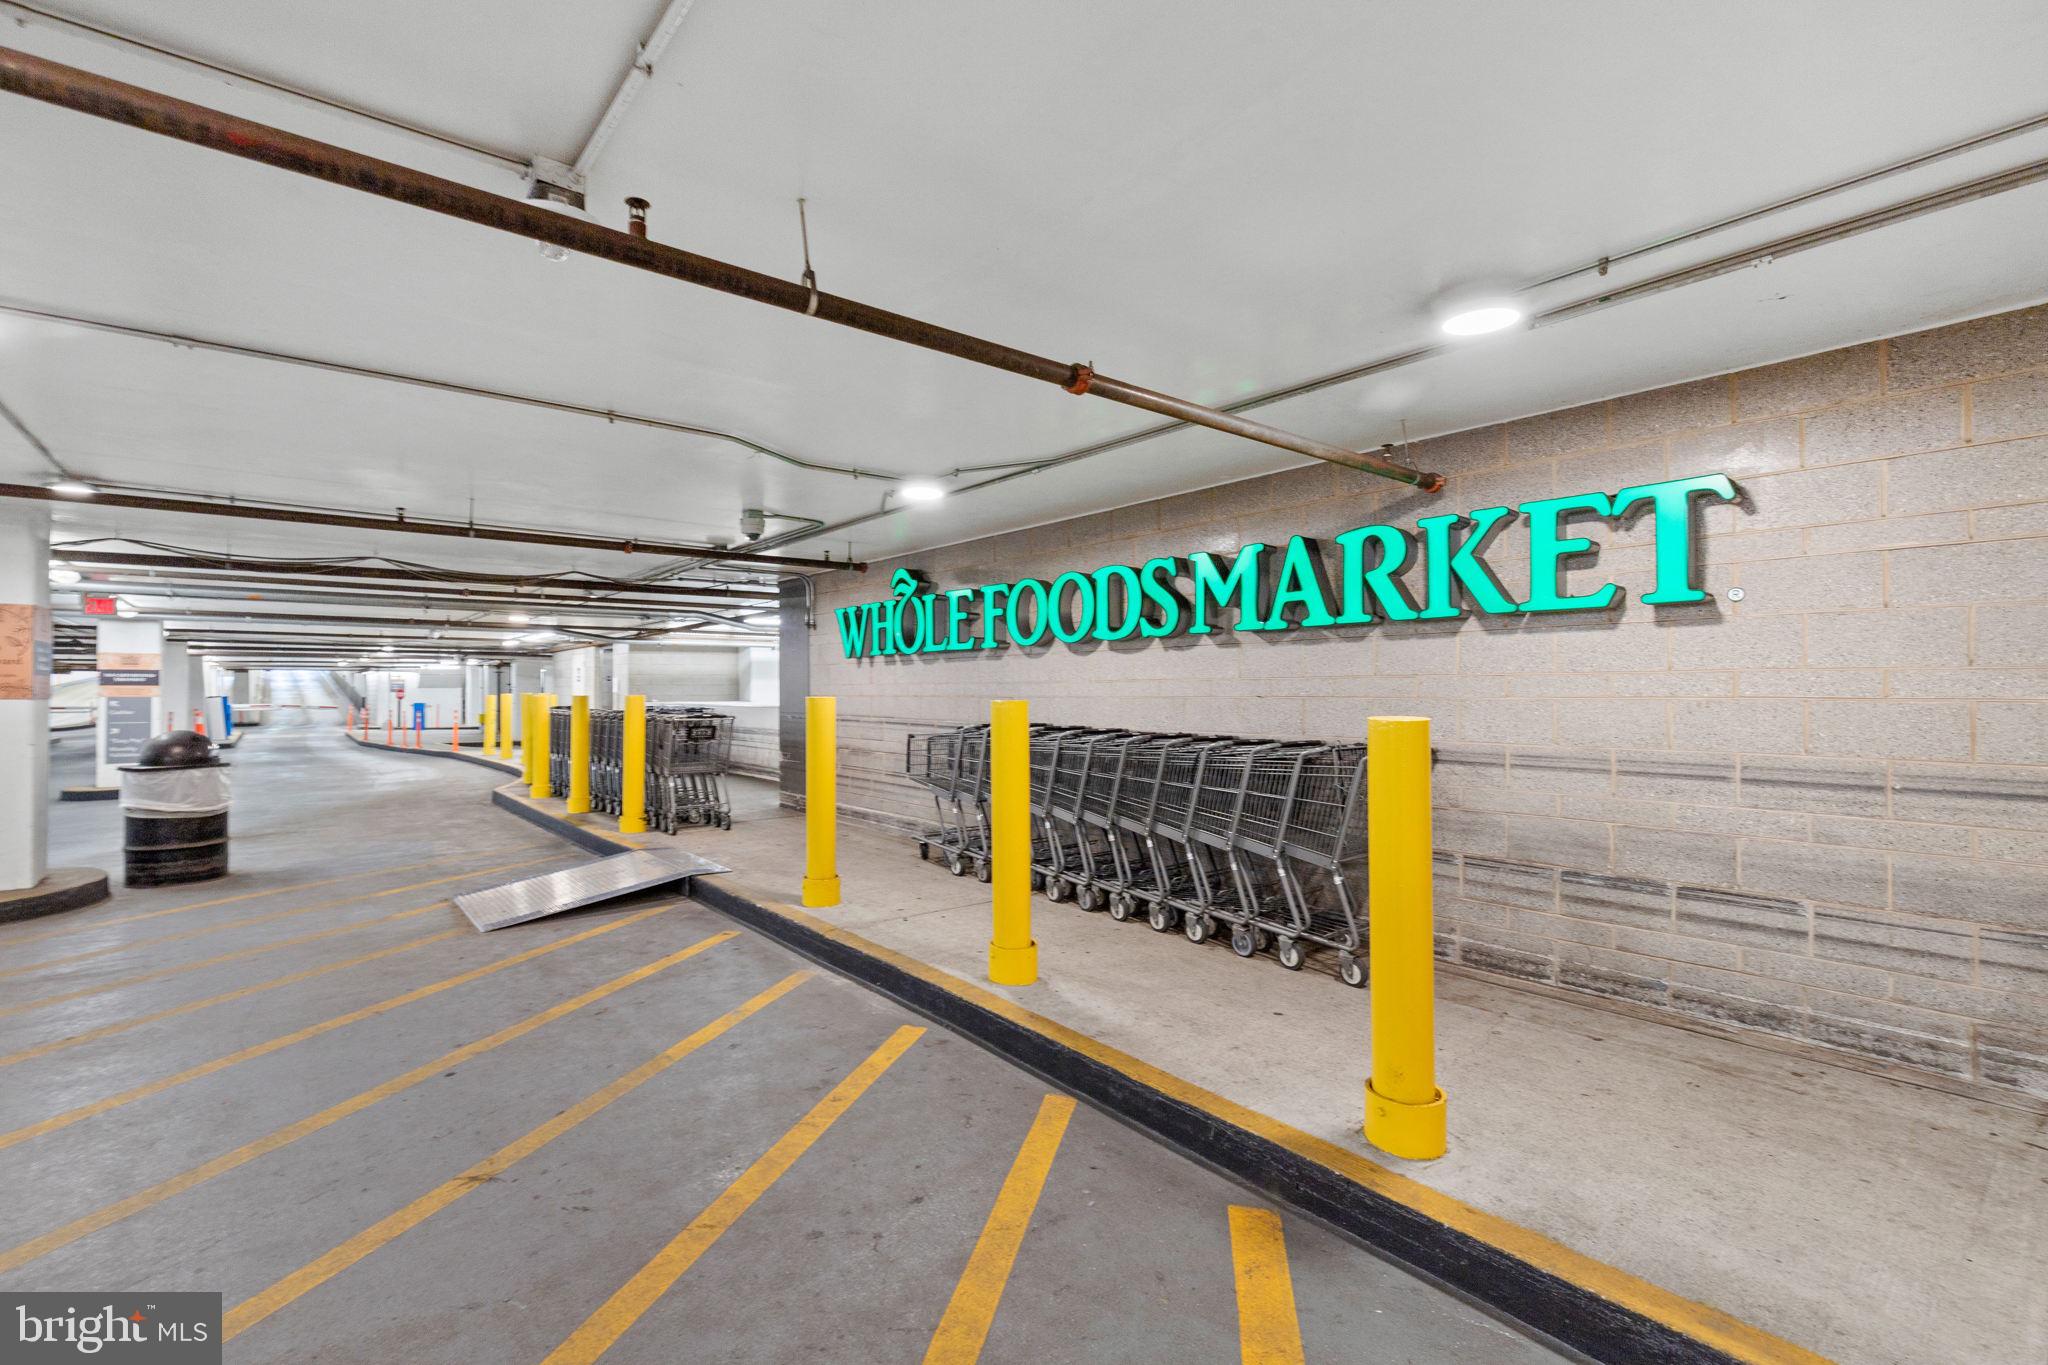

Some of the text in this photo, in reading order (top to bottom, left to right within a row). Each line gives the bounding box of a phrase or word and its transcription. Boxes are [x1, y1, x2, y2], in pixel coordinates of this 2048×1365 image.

[834, 567, 975, 659] WHOLE
[979, 555, 1179, 650] FOODS
[1187, 476, 1737, 634] MARKET
